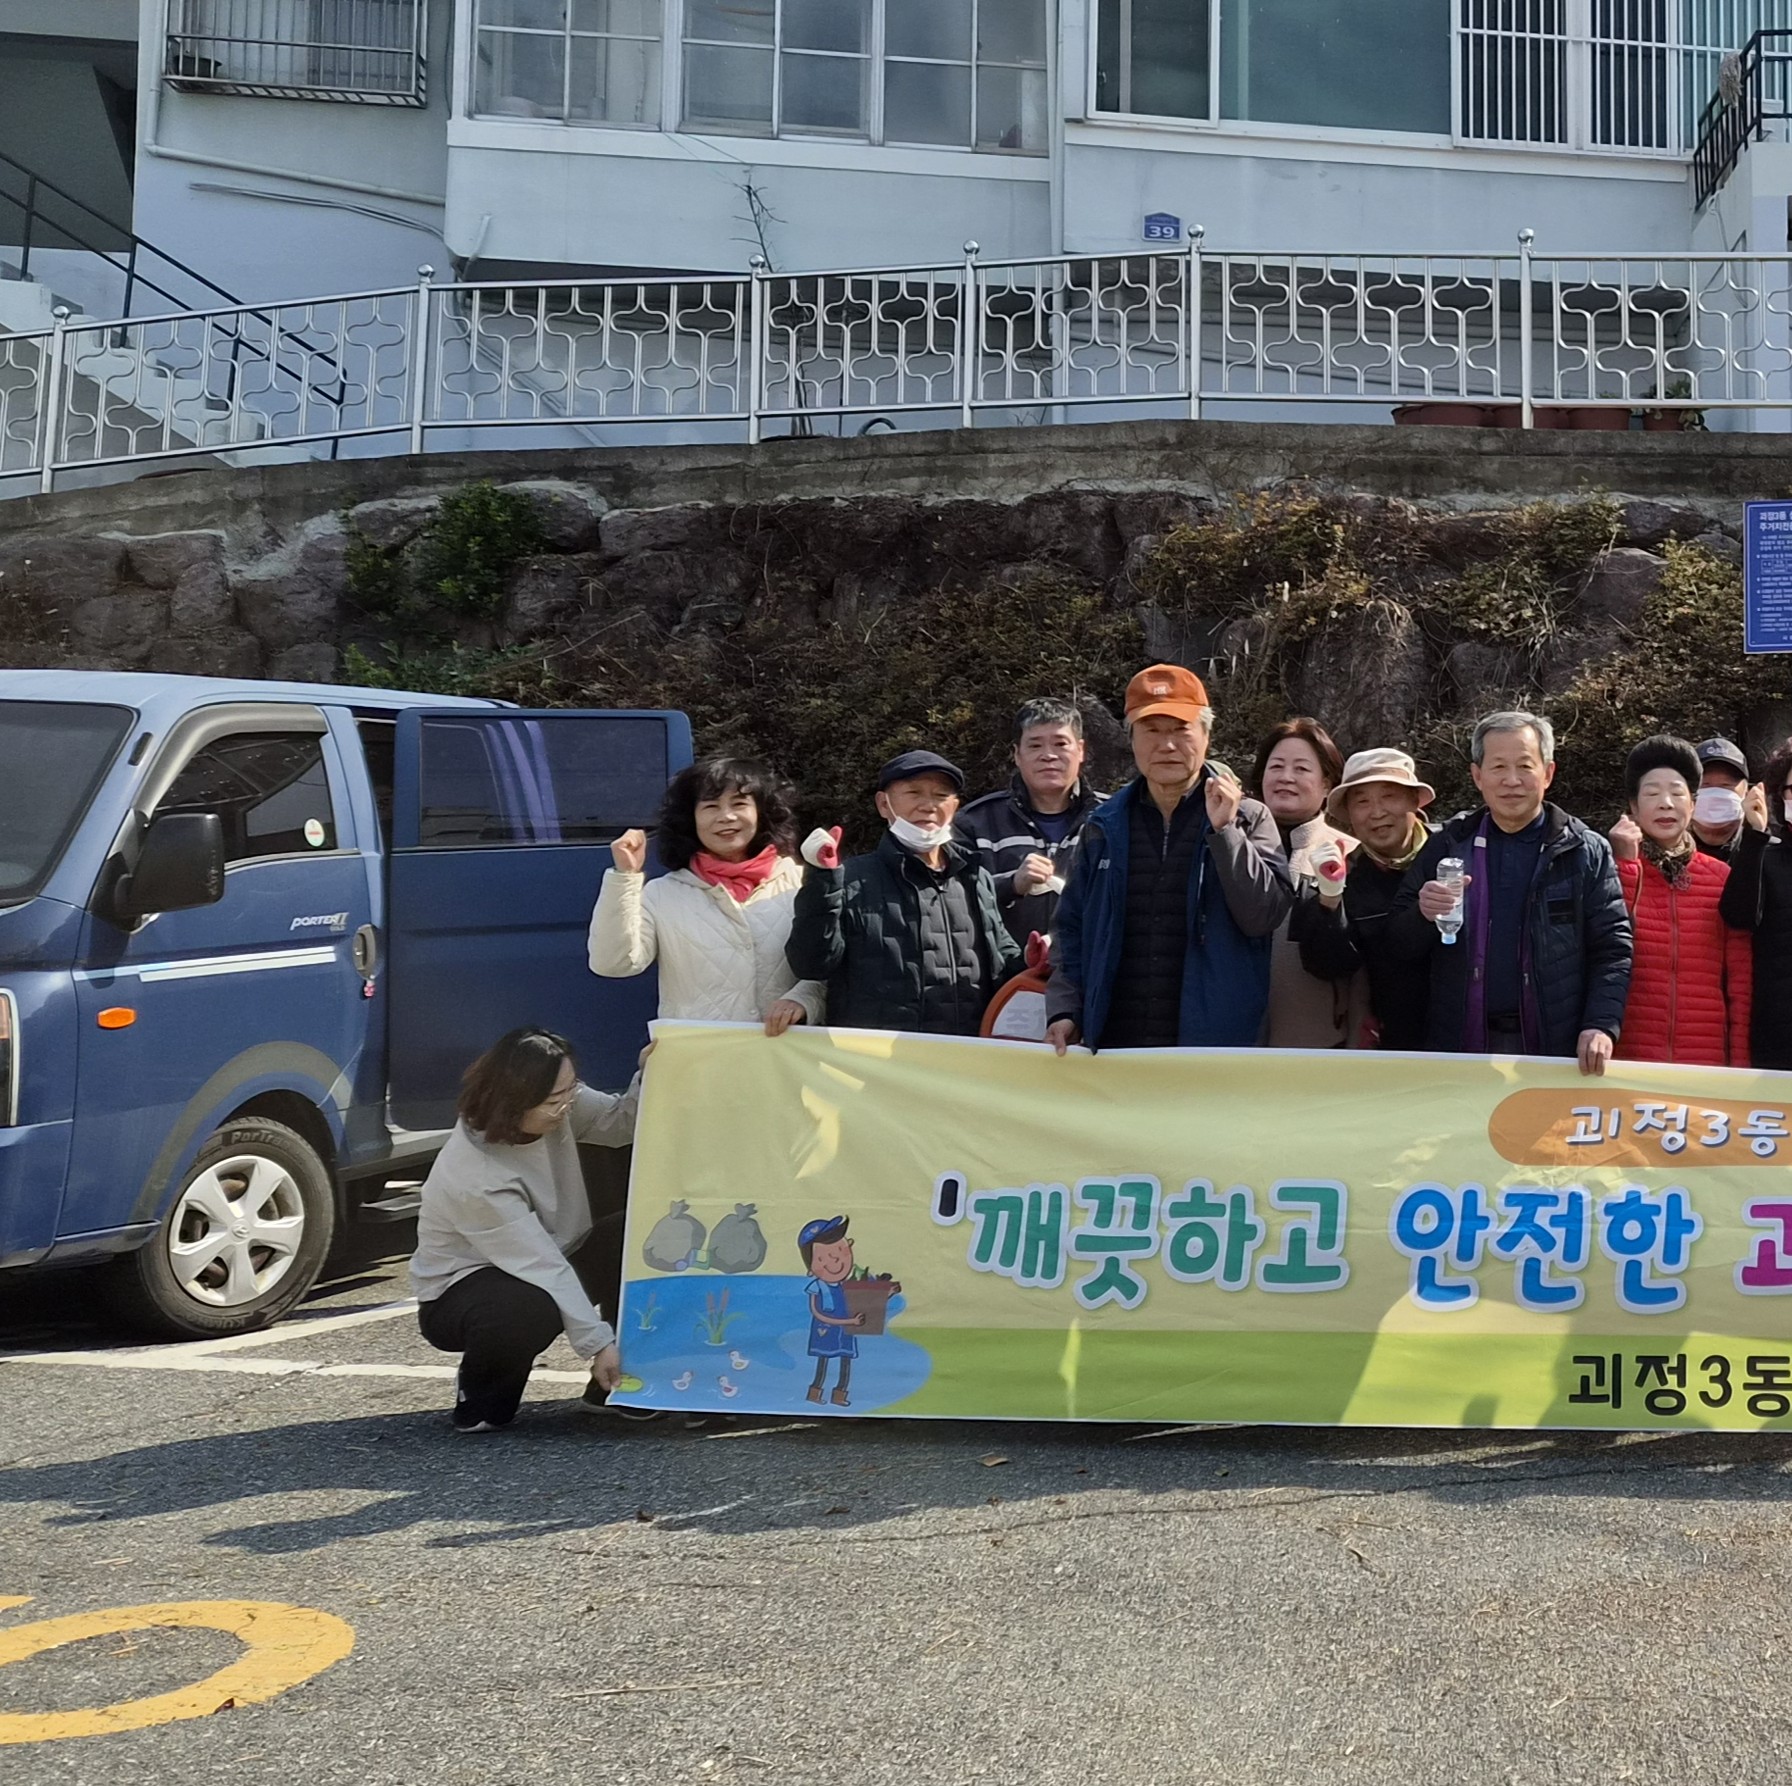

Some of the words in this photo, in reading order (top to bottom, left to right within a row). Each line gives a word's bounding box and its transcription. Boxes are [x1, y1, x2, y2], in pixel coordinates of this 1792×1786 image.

[1148, 225, 1175, 238] 39
[1565, 1102, 1791, 1158] 괴정3동
[936, 1176, 1346, 1304] '깨끗하고
[1396, 1186, 1699, 1305] 안전한
